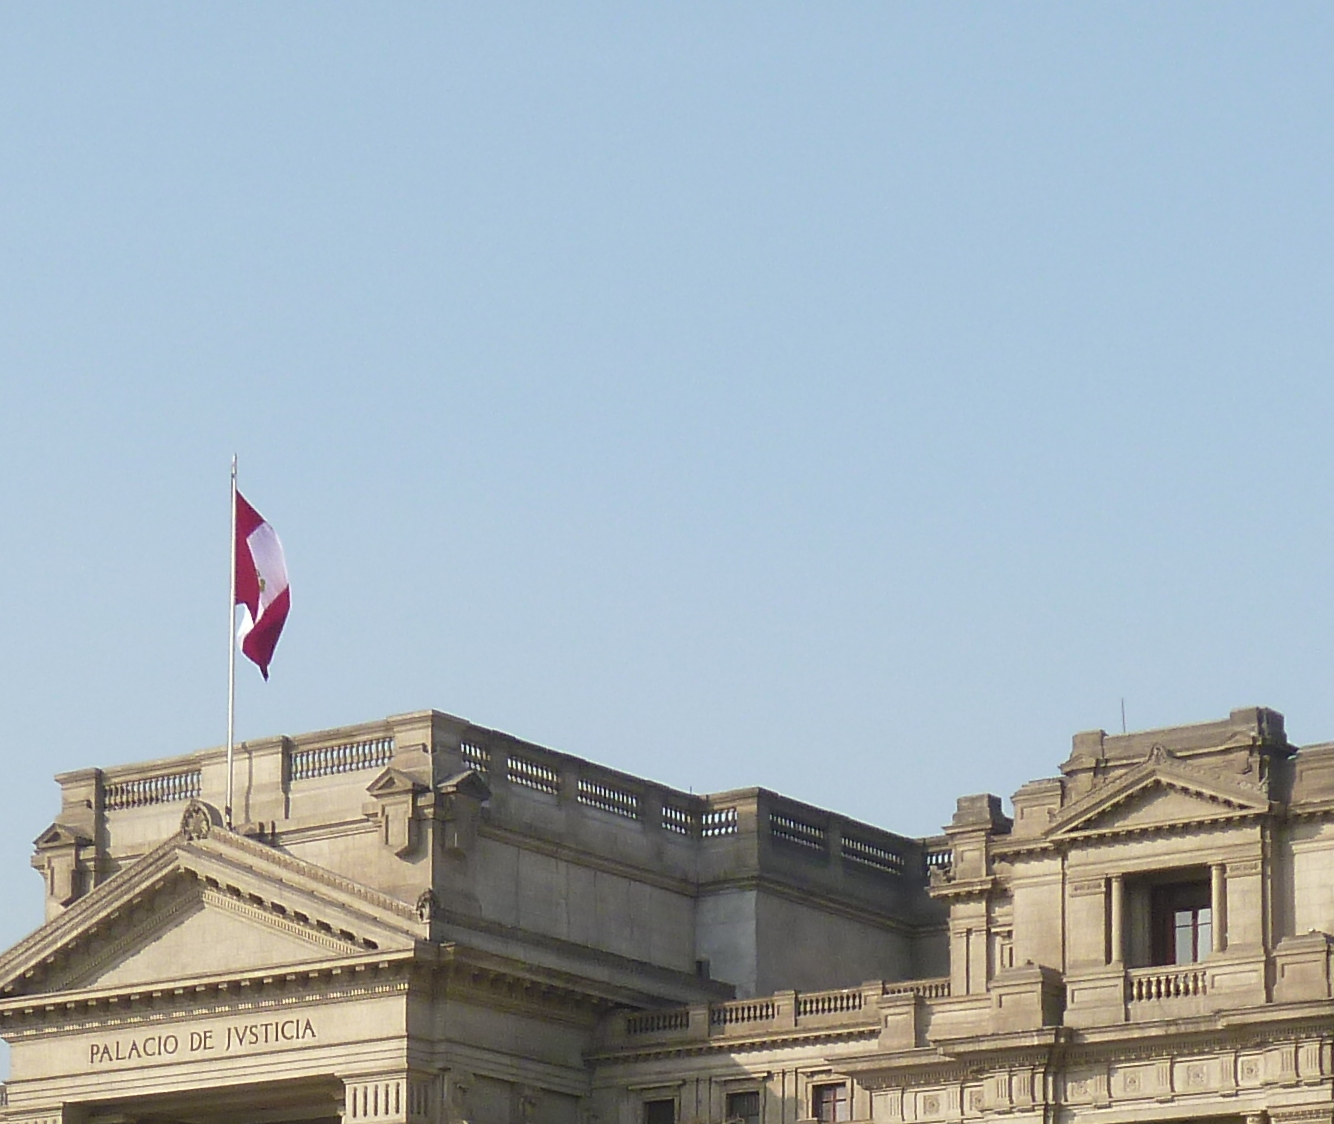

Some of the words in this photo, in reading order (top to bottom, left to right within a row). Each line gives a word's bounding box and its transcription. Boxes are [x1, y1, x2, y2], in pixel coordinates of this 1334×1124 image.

[90, 1035, 178, 1063] PALACIO
[189, 1030, 214, 1052] DE
[226, 1018, 316, 1050] JVSTICIA
